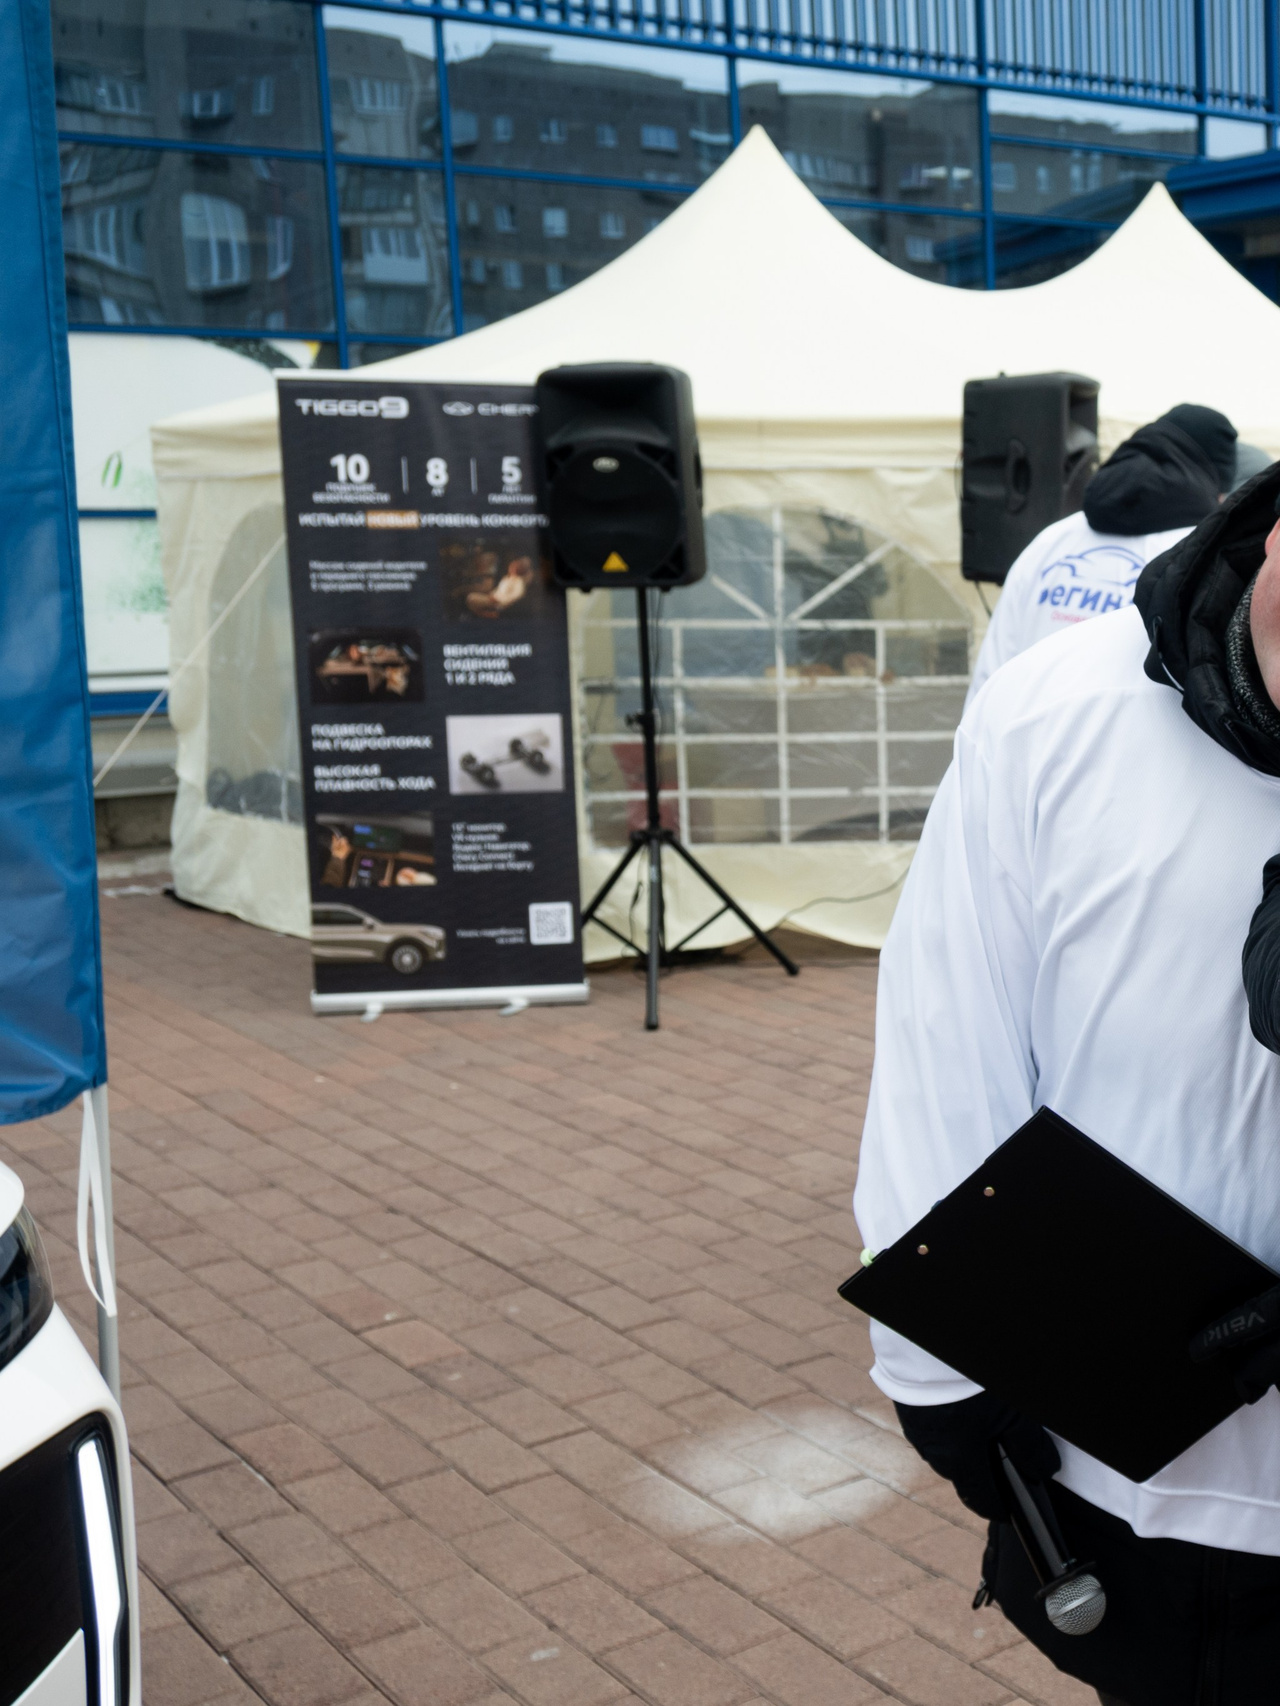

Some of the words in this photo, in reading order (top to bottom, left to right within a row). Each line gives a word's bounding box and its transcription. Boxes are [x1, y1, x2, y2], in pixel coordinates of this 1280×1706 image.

[330, 453, 370, 484] 10
[426, 457, 449, 488] 8
[501, 456, 522, 485] 5
[298, 511, 365, 528] ИСПЫТАЙ
[420, 513, 480, 528] УРОВЕНЬ
[314, 763, 381, 779] ВЫСОКАЯ
